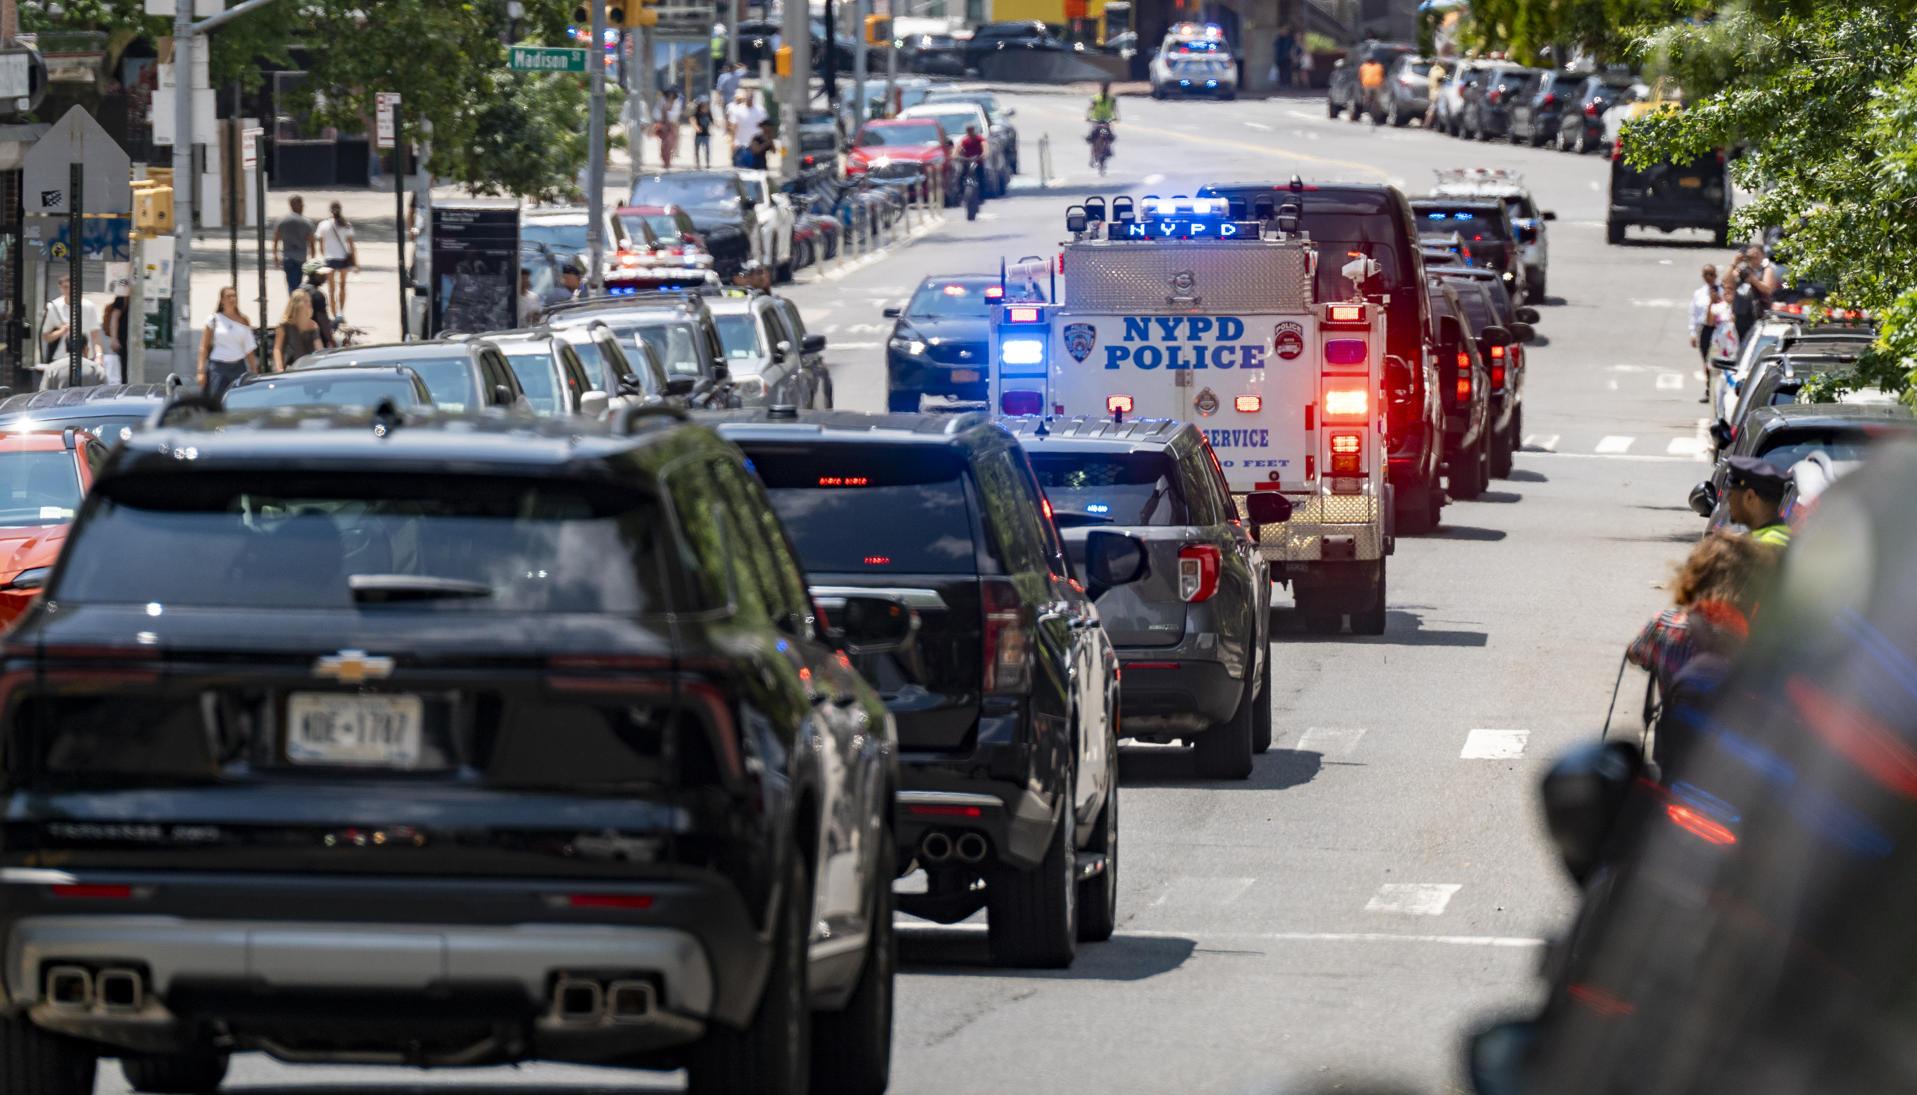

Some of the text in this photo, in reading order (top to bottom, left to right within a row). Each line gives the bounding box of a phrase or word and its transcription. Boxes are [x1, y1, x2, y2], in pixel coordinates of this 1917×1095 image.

[515, 50, 568, 68] Madison
[1130, 223, 1236, 236] NYPD
[1123, 316, 1245, 341] NYPD
[1275, 322, 1302, 334] POLICE
[1104, 345, 1265, 370] POLICE
